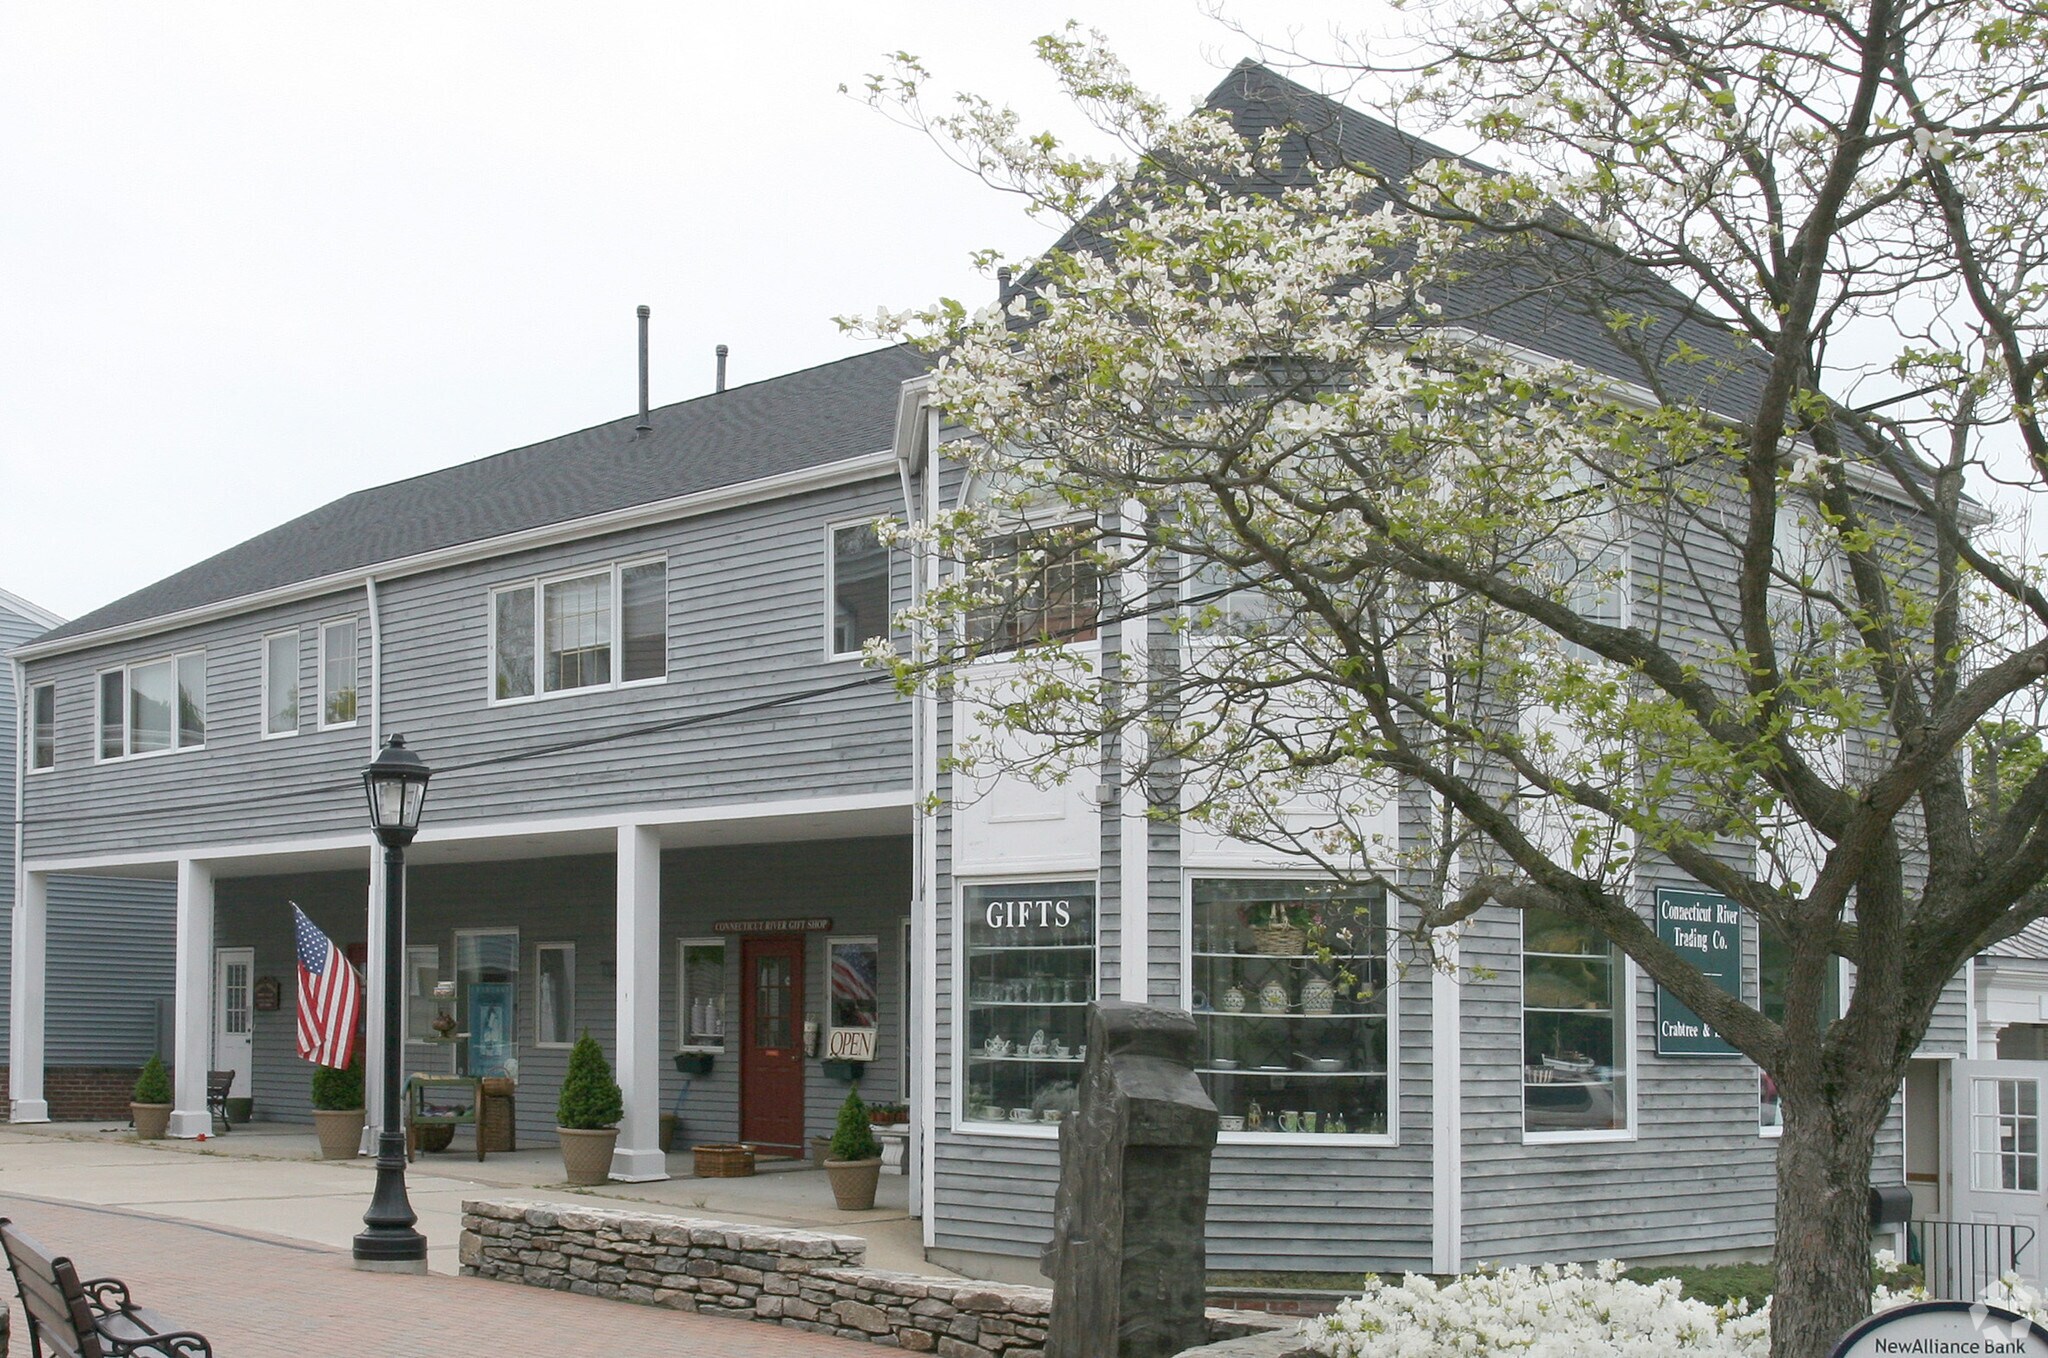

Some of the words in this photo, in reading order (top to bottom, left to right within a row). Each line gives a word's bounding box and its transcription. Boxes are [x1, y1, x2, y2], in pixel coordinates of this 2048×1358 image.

[715, 921, 763, 931] CONNECTICUT
[765, 920, 788, 930] RIVER
[788, 919, 806, 929] GIFT
[807, 919, 828, 929] SHOP
[986, 900, 1070, 928] GIFTS
[1661, 900, 1712, 922] Connecticut
[1716, 904, 1738, 925] River
[1674, 927, 1708, 953] Trading
[1712, 929, 1728, 950] Co.
[1661, 1020, 1699, 1037] Crabtree
[1702, 1023, 1711, 1037] &
[829, 1031, 873, 1057] OPEN
[1875, 1338, 1980, 1354] NewAlliance
[1984, 1338, 2026, 1354] Bank
